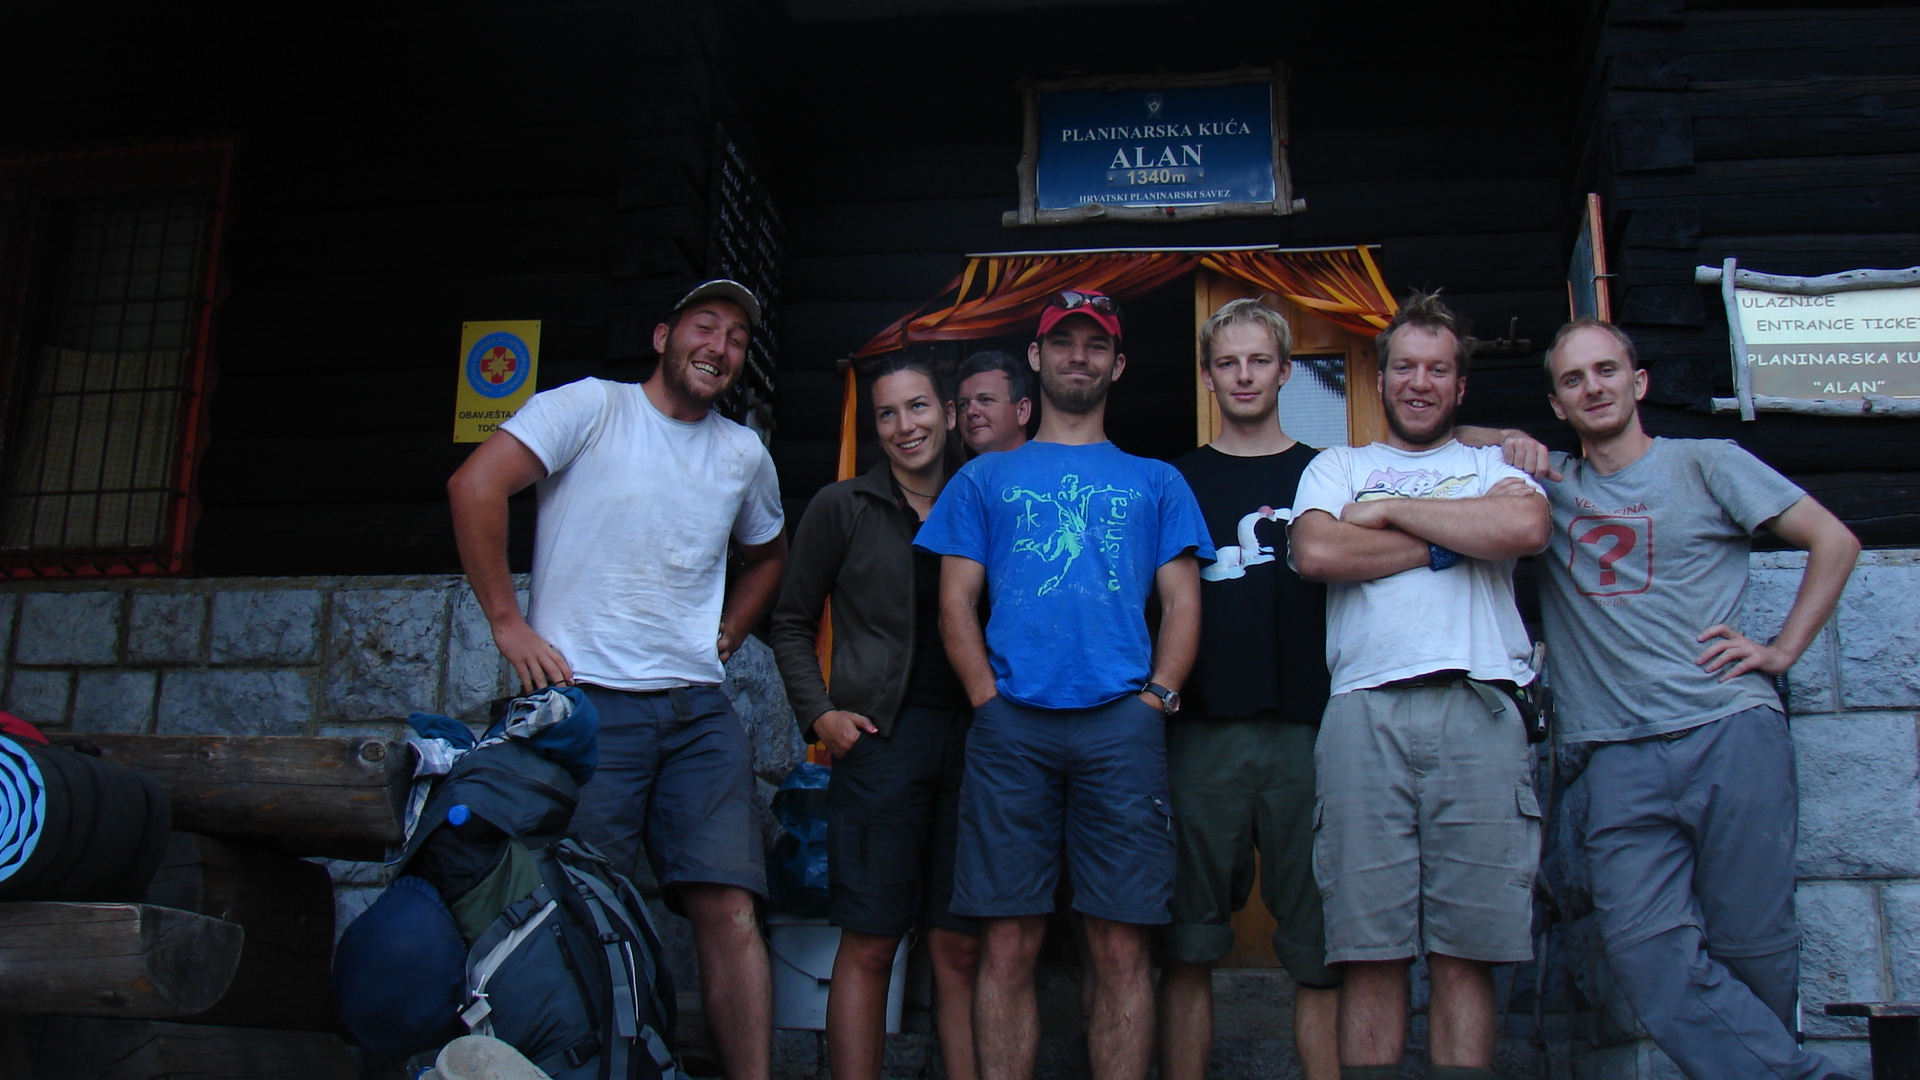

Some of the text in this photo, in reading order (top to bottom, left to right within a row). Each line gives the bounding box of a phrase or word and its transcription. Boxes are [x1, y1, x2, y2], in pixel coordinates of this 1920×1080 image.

[1061, 117, 1251, 142] PLANINARSKA KUĆA
[1109, 143, 1203, 170] ALAN
[1079, 189, 1231, 203] HRVATSKI PLANINARSKI SAVEZ
[1741, 295, 1835, 309] ULAZNICE
[1756, 318, 1854, 332] ENTRANCE
[1747, 352, 1889, 366] PLANINARSKA
